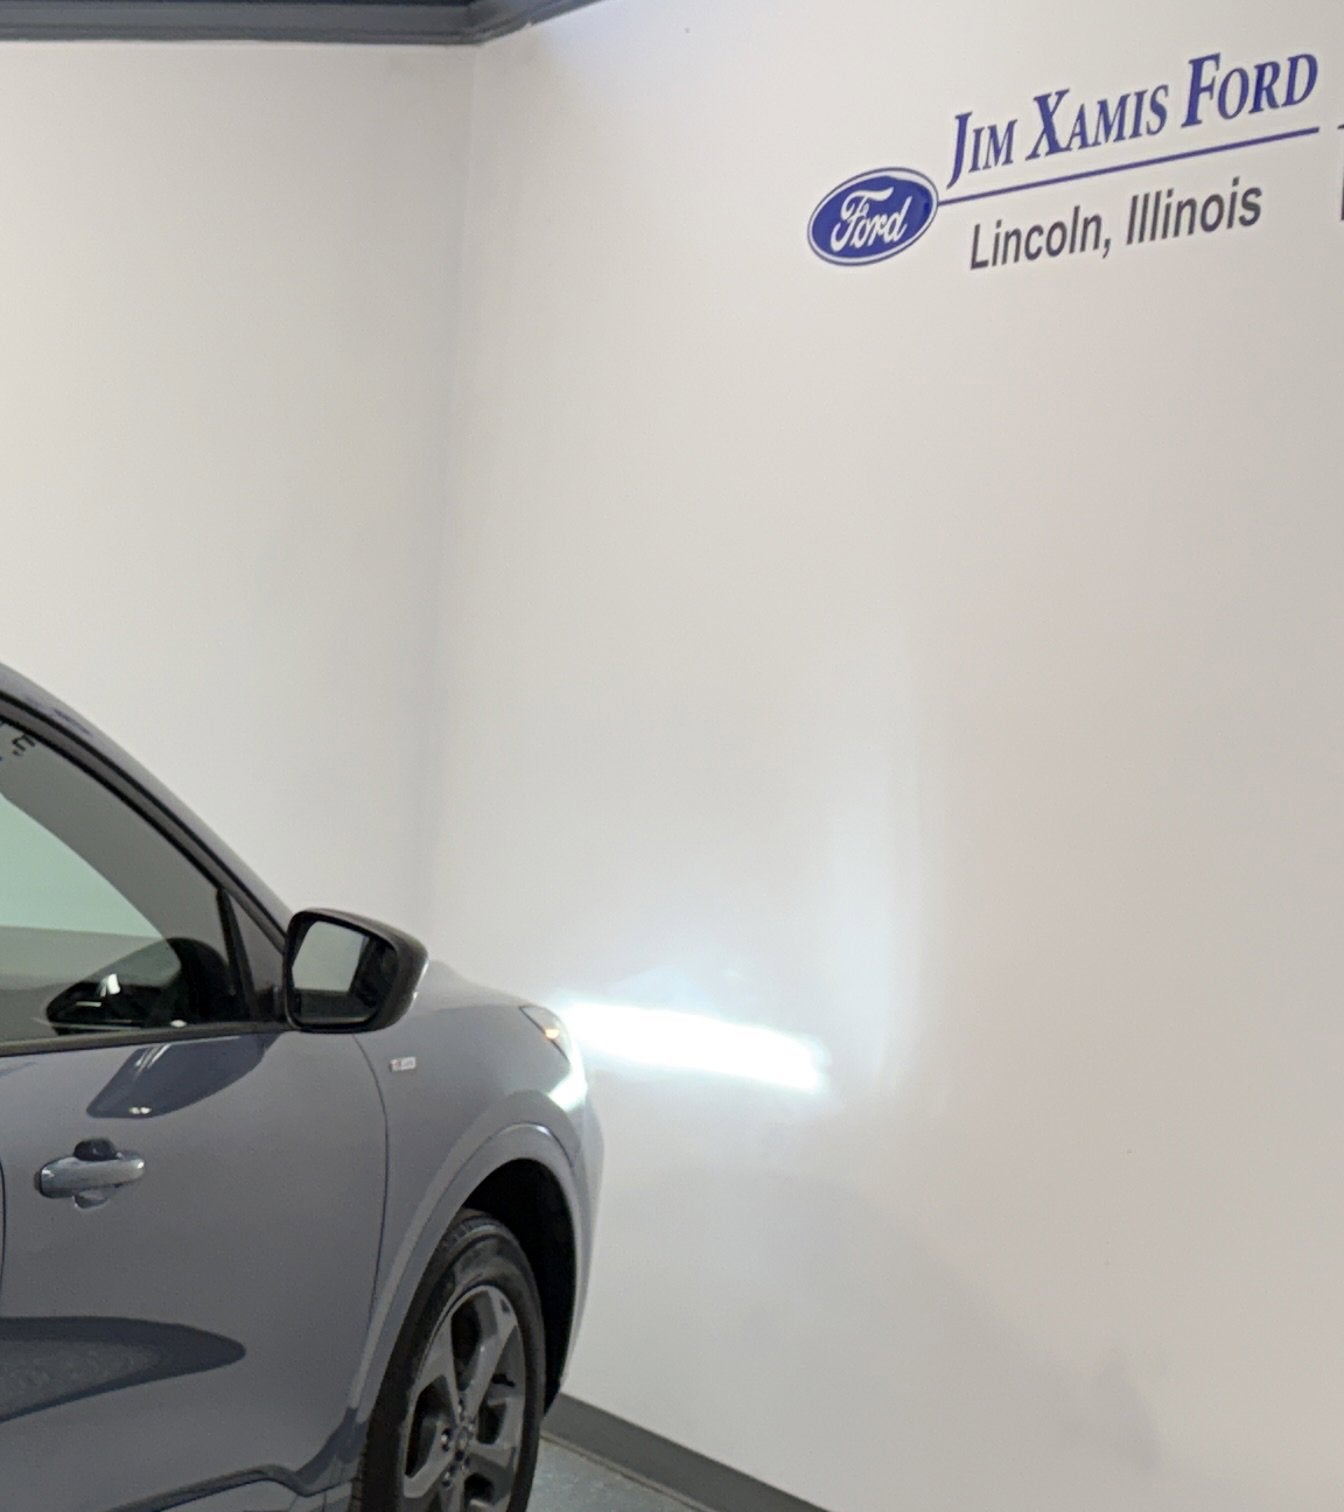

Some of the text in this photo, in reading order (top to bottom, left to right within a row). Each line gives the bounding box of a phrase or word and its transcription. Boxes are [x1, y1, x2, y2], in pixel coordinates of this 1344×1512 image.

[946, 52, 1319, 189] JIM XAMIS FORD
[830, 186, 913, 252] Ford
[970, 177, 1263, 270] Lincoln, Illinois
